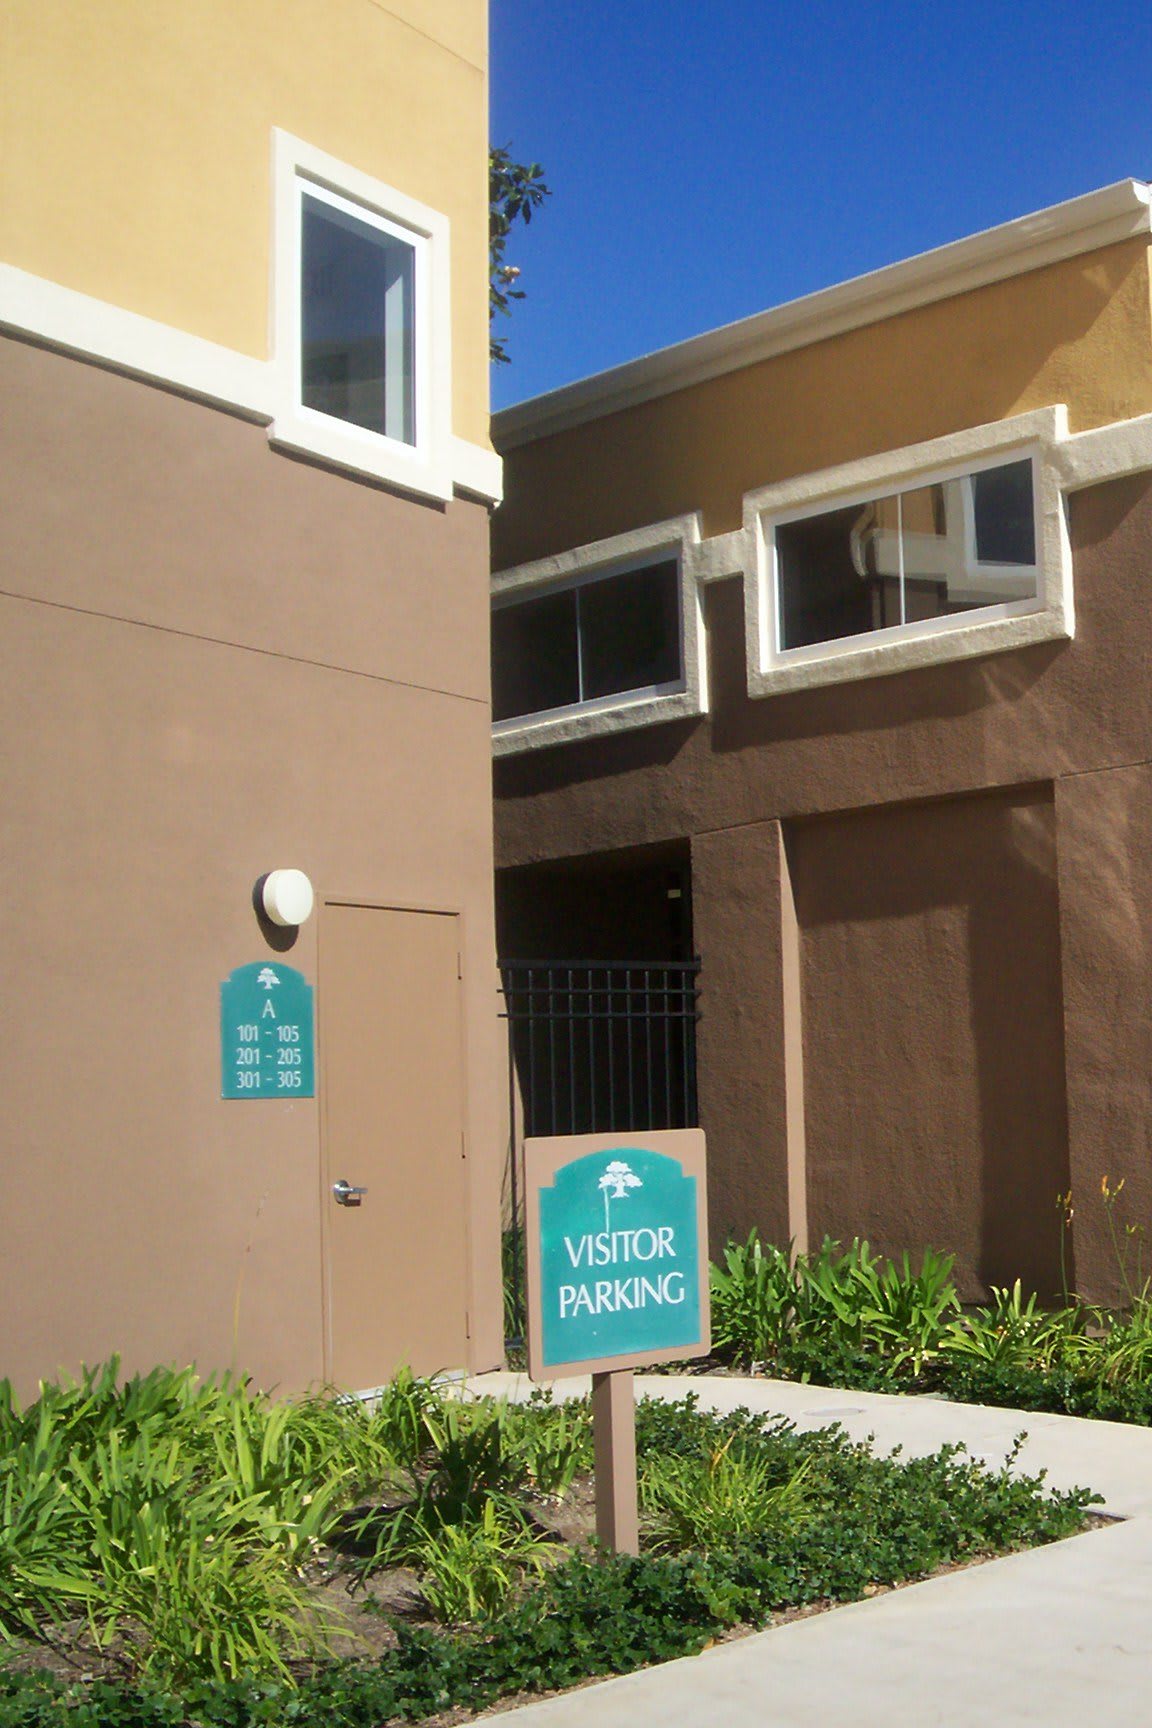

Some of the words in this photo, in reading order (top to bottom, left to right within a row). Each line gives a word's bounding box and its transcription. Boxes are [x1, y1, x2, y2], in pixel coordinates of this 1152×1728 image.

[262, 999, 276, 1019] A
[236, 1024, 259, 1042] 101
[277, 1025, 299, 1042] 105
[236, 1047, 260, 1065] 201
[277, 1048, 301, 1065] 205
[236, 1071, 260, 1088] 301
[277, 1070, 302, 1088] 305
[564, 1226, 677, 1268] VISITOR
[559, 1271, 685, 1319] PARKING
